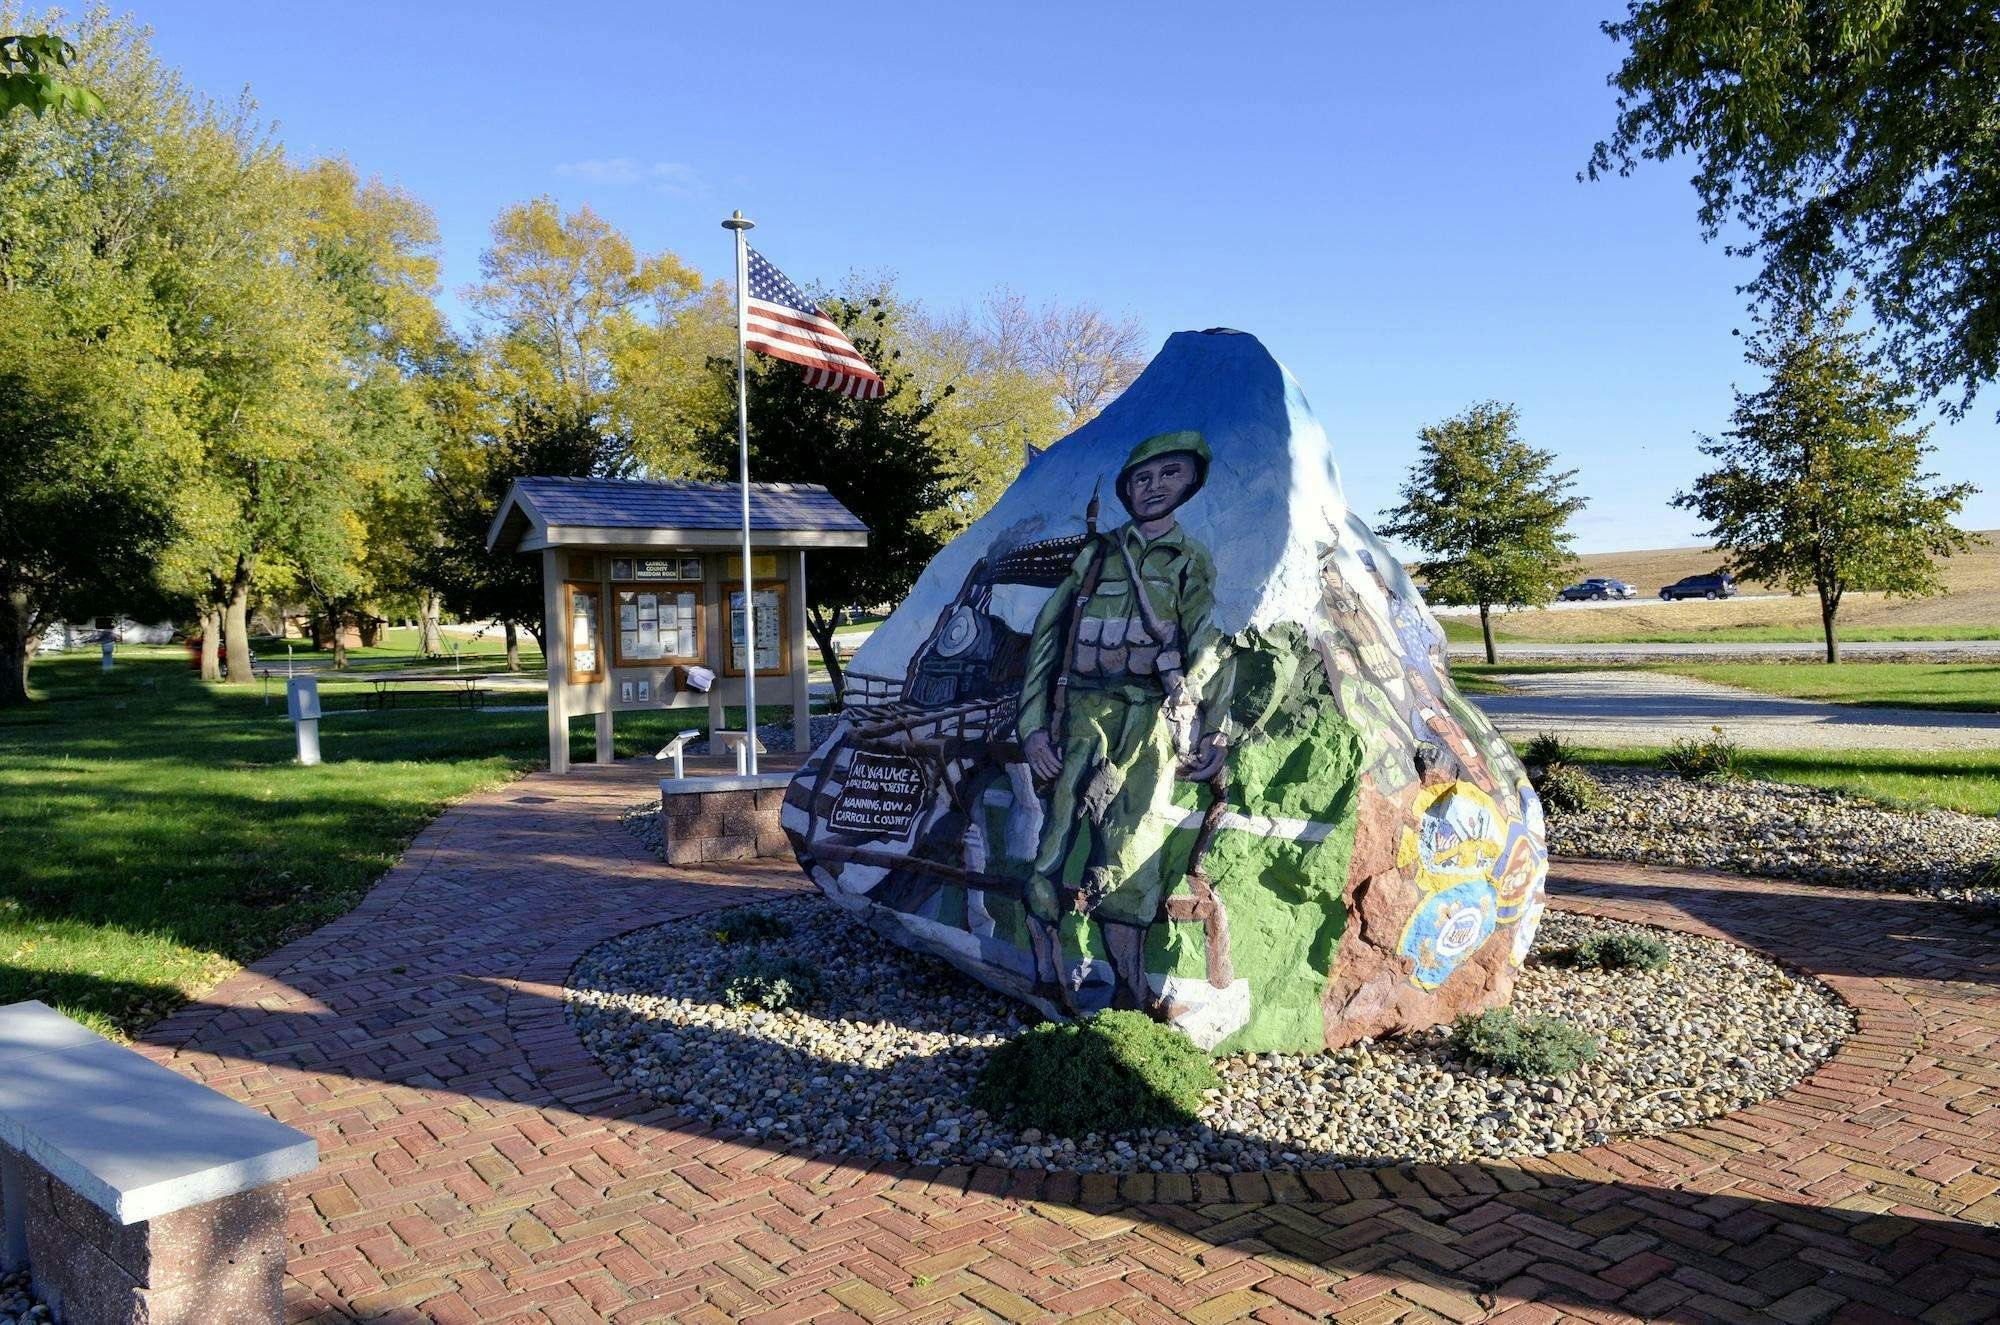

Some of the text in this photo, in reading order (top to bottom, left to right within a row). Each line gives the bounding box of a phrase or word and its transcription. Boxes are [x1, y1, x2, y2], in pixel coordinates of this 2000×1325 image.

[880, 782, 918, 794] TRESTLE
[882, 801, 913, 812] IOWA
[836, 811, 912, 826] CARROLL COUNTY
